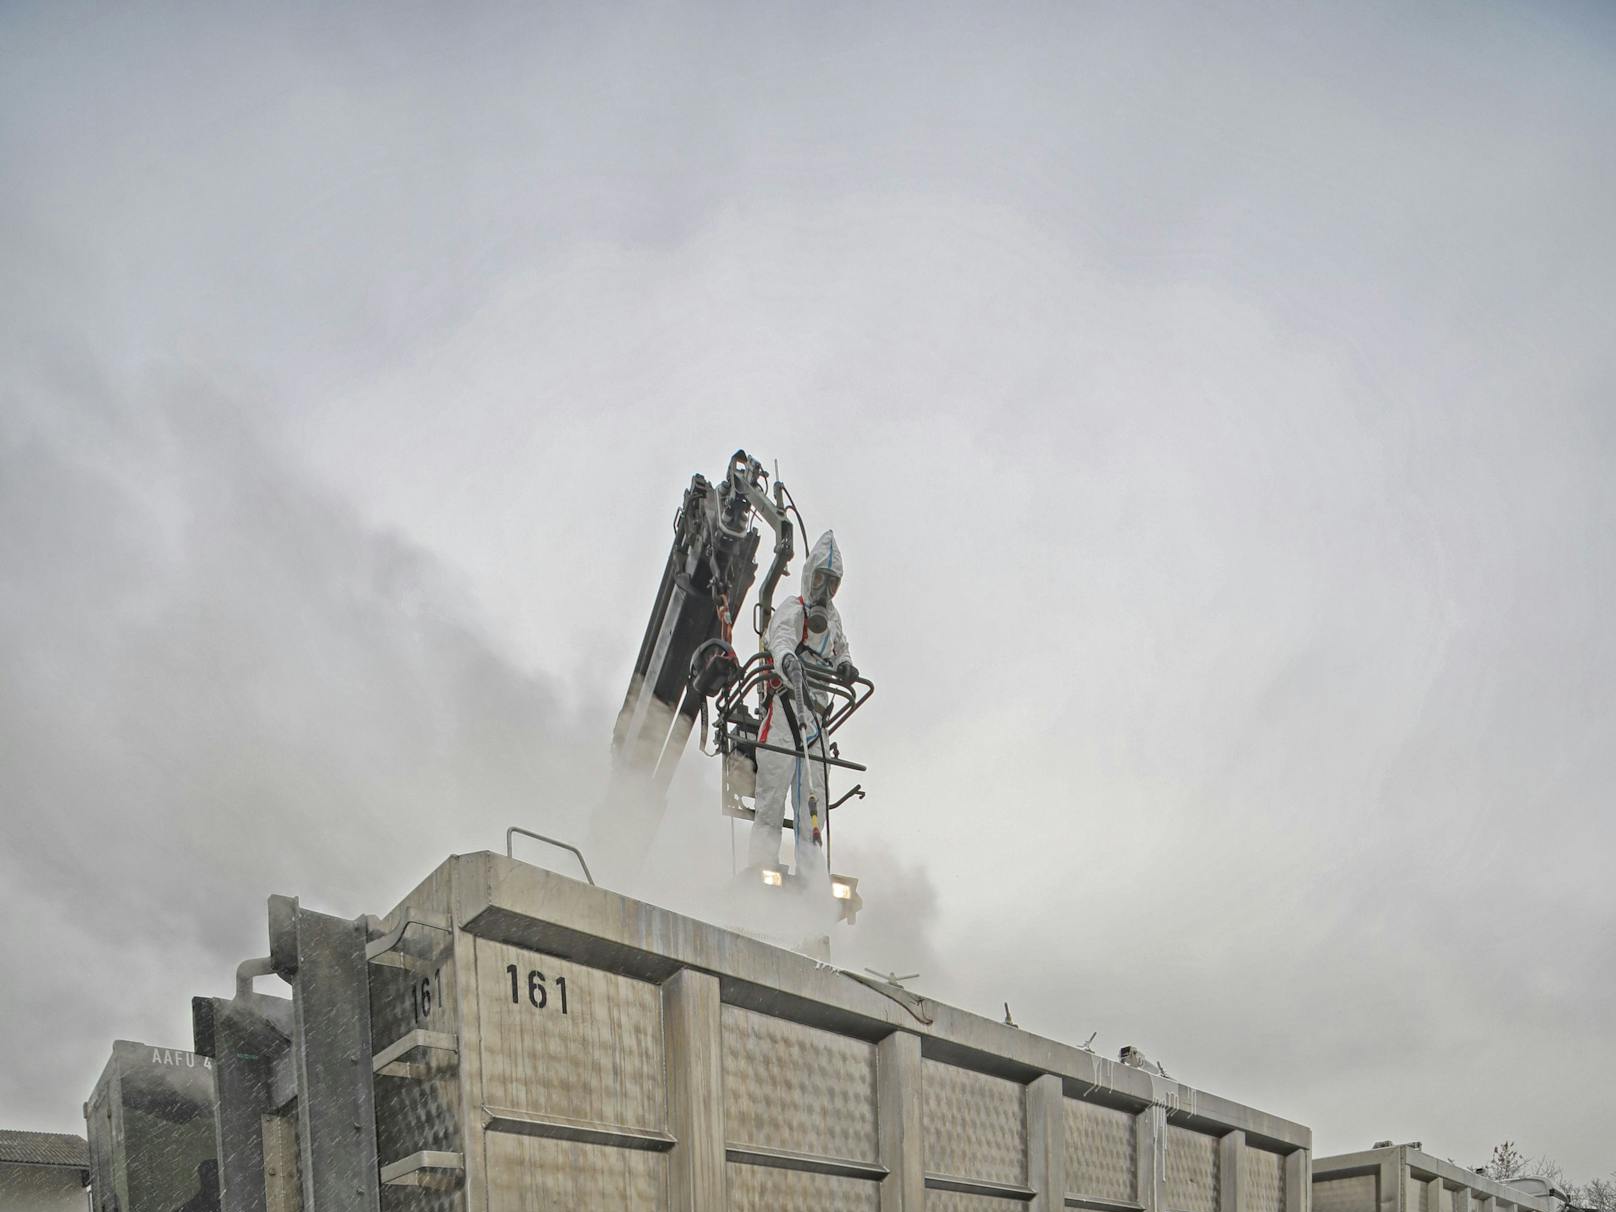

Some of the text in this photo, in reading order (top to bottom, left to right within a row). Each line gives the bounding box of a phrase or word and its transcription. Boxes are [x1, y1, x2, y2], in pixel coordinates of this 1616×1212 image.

[412, 968, 442, 1024] 161
[506, 964, 567, 1015] 161
[152, 1048, 194, 1068] AAFU
